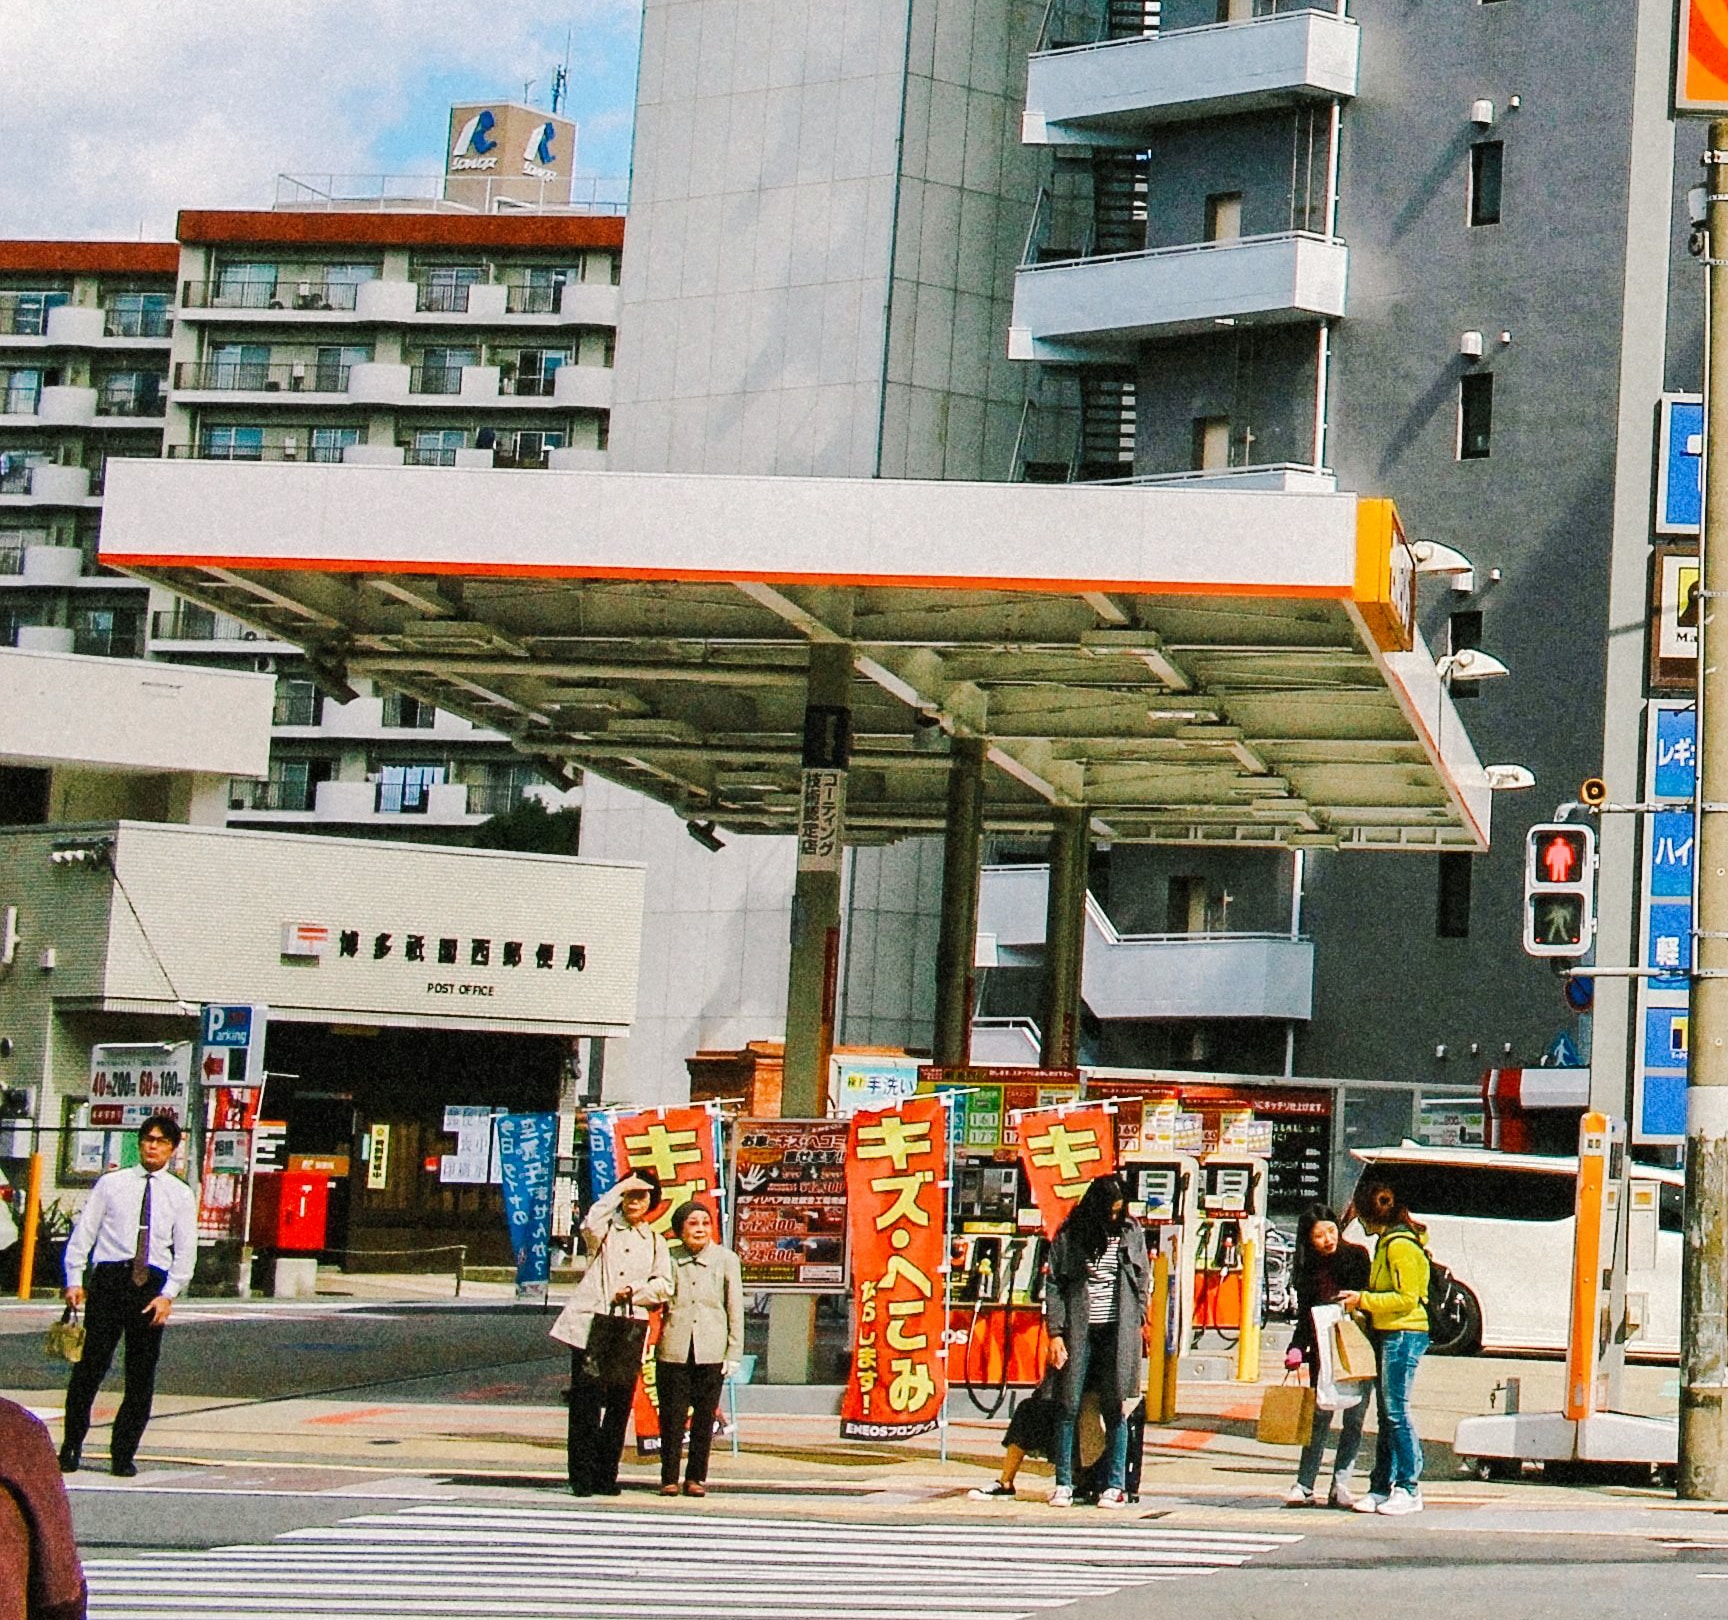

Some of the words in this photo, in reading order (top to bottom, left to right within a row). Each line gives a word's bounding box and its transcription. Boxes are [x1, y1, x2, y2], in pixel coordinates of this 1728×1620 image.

[1658, 737, 1696, 767] レギュ
[1655, 837, 1694, 866] ハイ
[427, 983, 454, 995] POST
[459, 984, 494, 996] OFFICE
[207, 1008, 246, 1043] Parking
